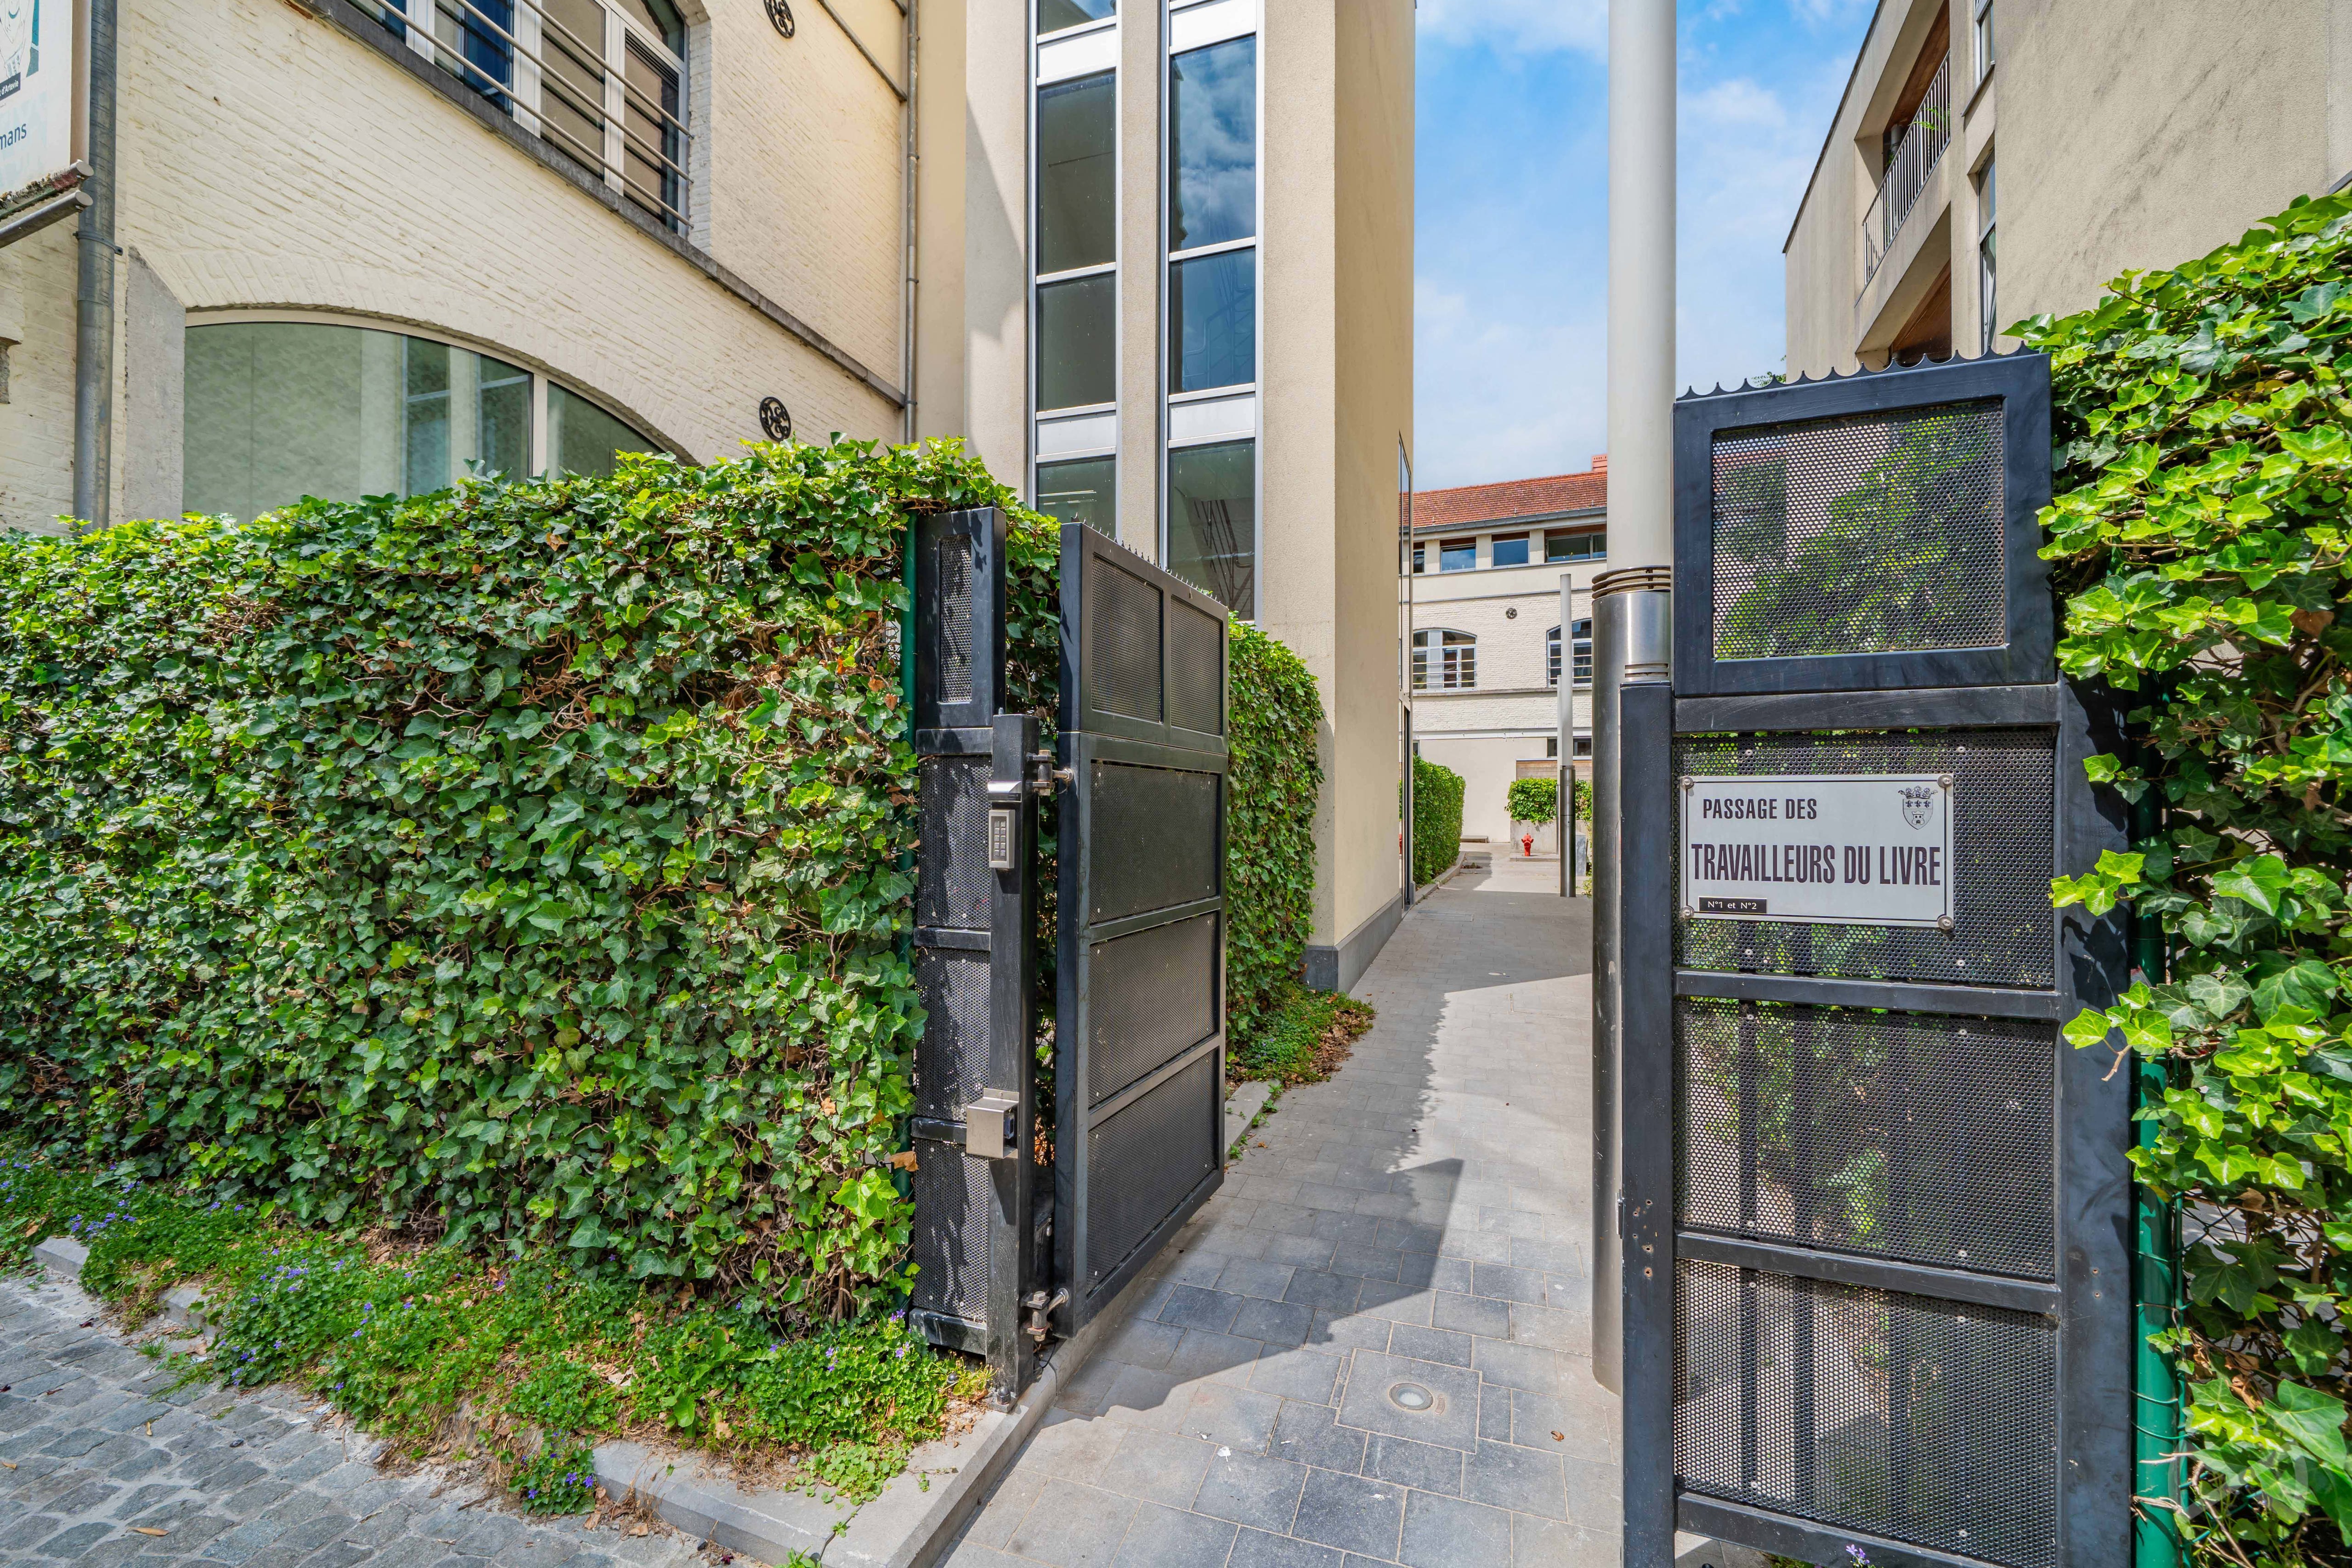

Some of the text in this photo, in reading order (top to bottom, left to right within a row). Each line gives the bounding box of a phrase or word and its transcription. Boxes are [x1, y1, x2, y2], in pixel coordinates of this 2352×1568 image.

[1703, 798, 1817, 820] PASSAGE DES
[1691, 843, 1940, 886] TRAVAILLEURS DU LIVRE
